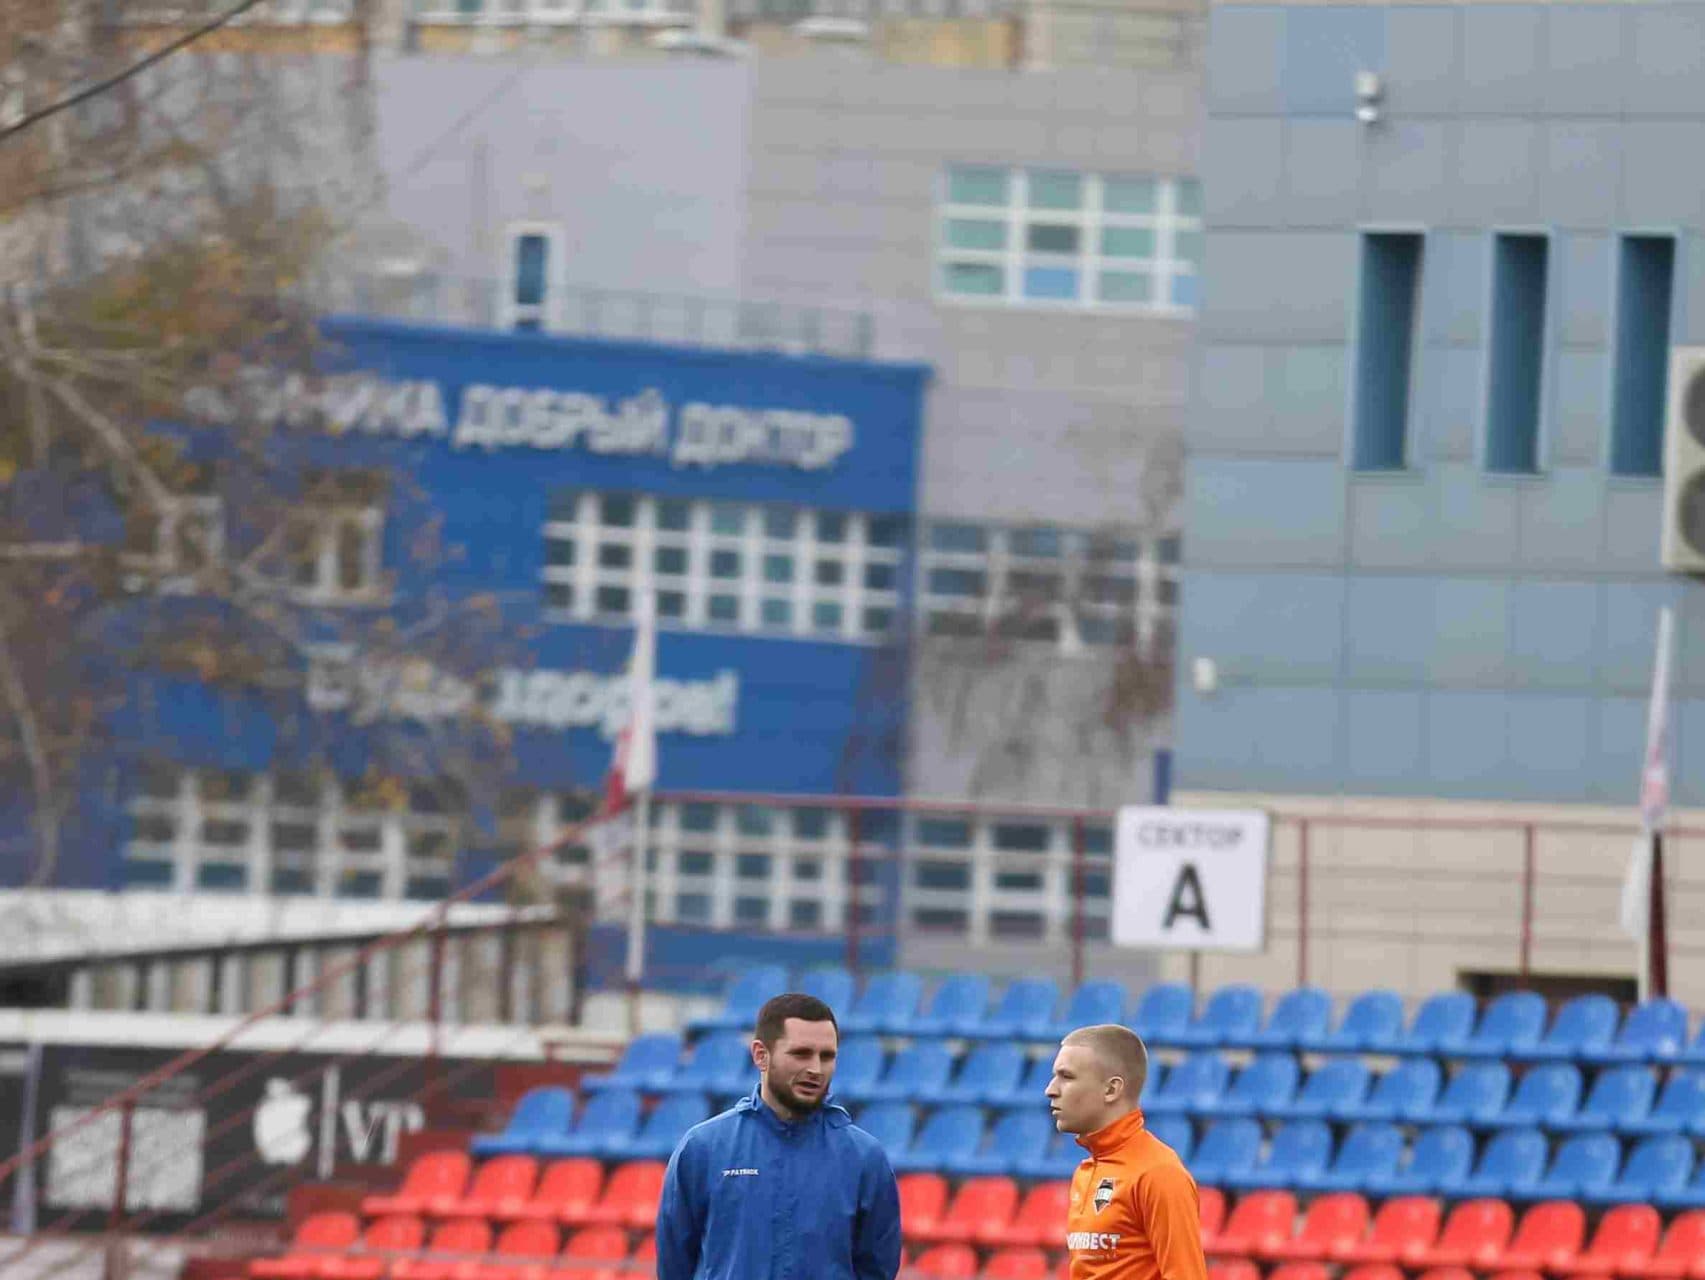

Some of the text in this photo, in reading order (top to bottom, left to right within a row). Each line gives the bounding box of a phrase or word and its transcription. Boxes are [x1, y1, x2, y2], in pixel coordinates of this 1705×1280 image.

[451, 384, 669, 457] ДОБРЫЙ
[672, 402, 854, 471] ДОКТОР
[1137, 822, 1244, 850] СЕКТОР
[1163, 862, 1211, 929] А
